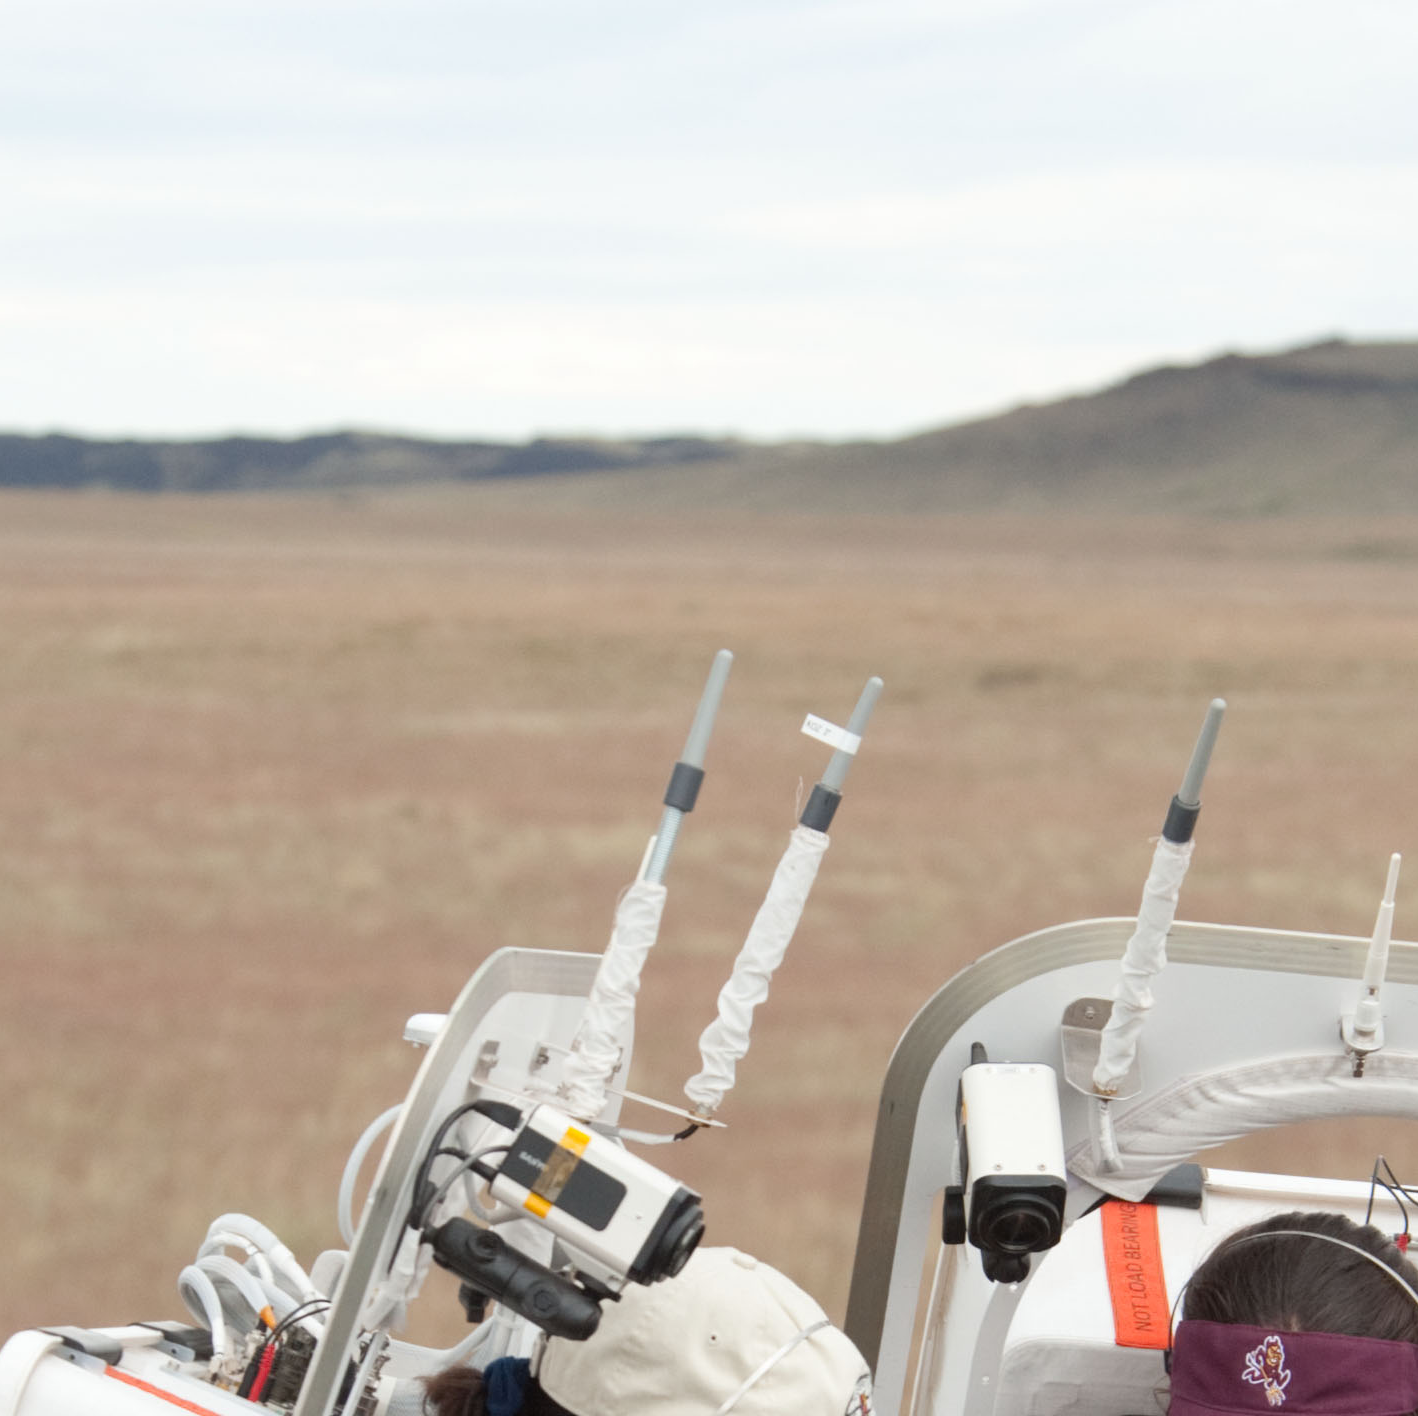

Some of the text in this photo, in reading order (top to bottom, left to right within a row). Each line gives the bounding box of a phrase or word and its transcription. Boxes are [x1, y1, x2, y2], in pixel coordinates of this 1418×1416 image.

[1119, 1201, 1153, 1332] NOT LOAD BEARING
